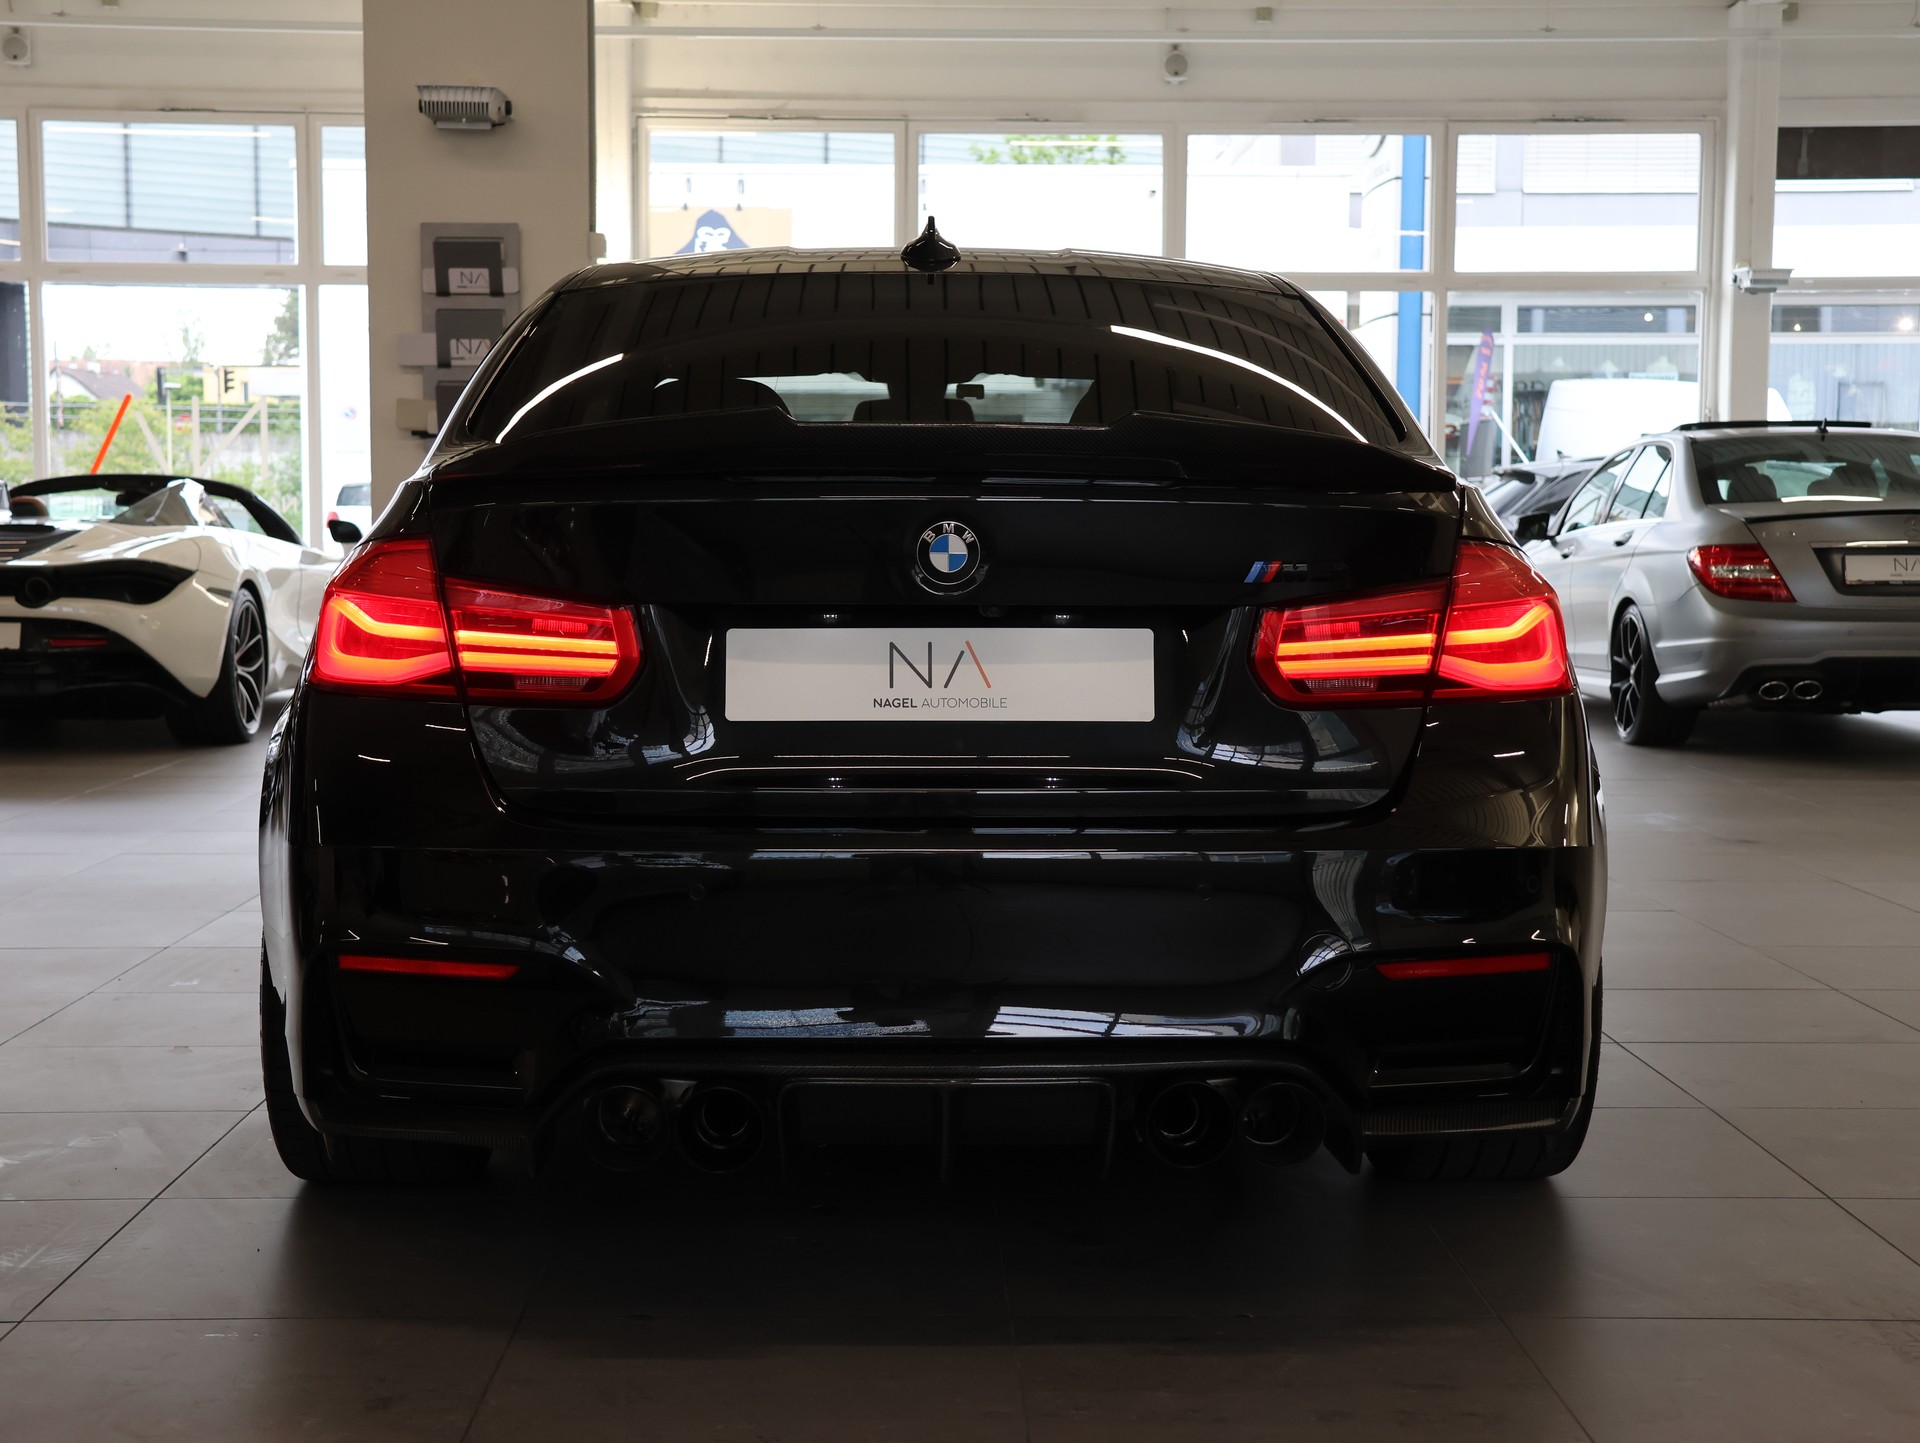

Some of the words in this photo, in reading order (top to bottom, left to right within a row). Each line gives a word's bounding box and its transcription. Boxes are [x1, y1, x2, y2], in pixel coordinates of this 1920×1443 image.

[923, 523, 974, 543] BMW
[889, 640, 992, 689] NA
[873, 697, 918, 709] NAGEL
[921, 697, 1008, 709] AUTOMOBILE
